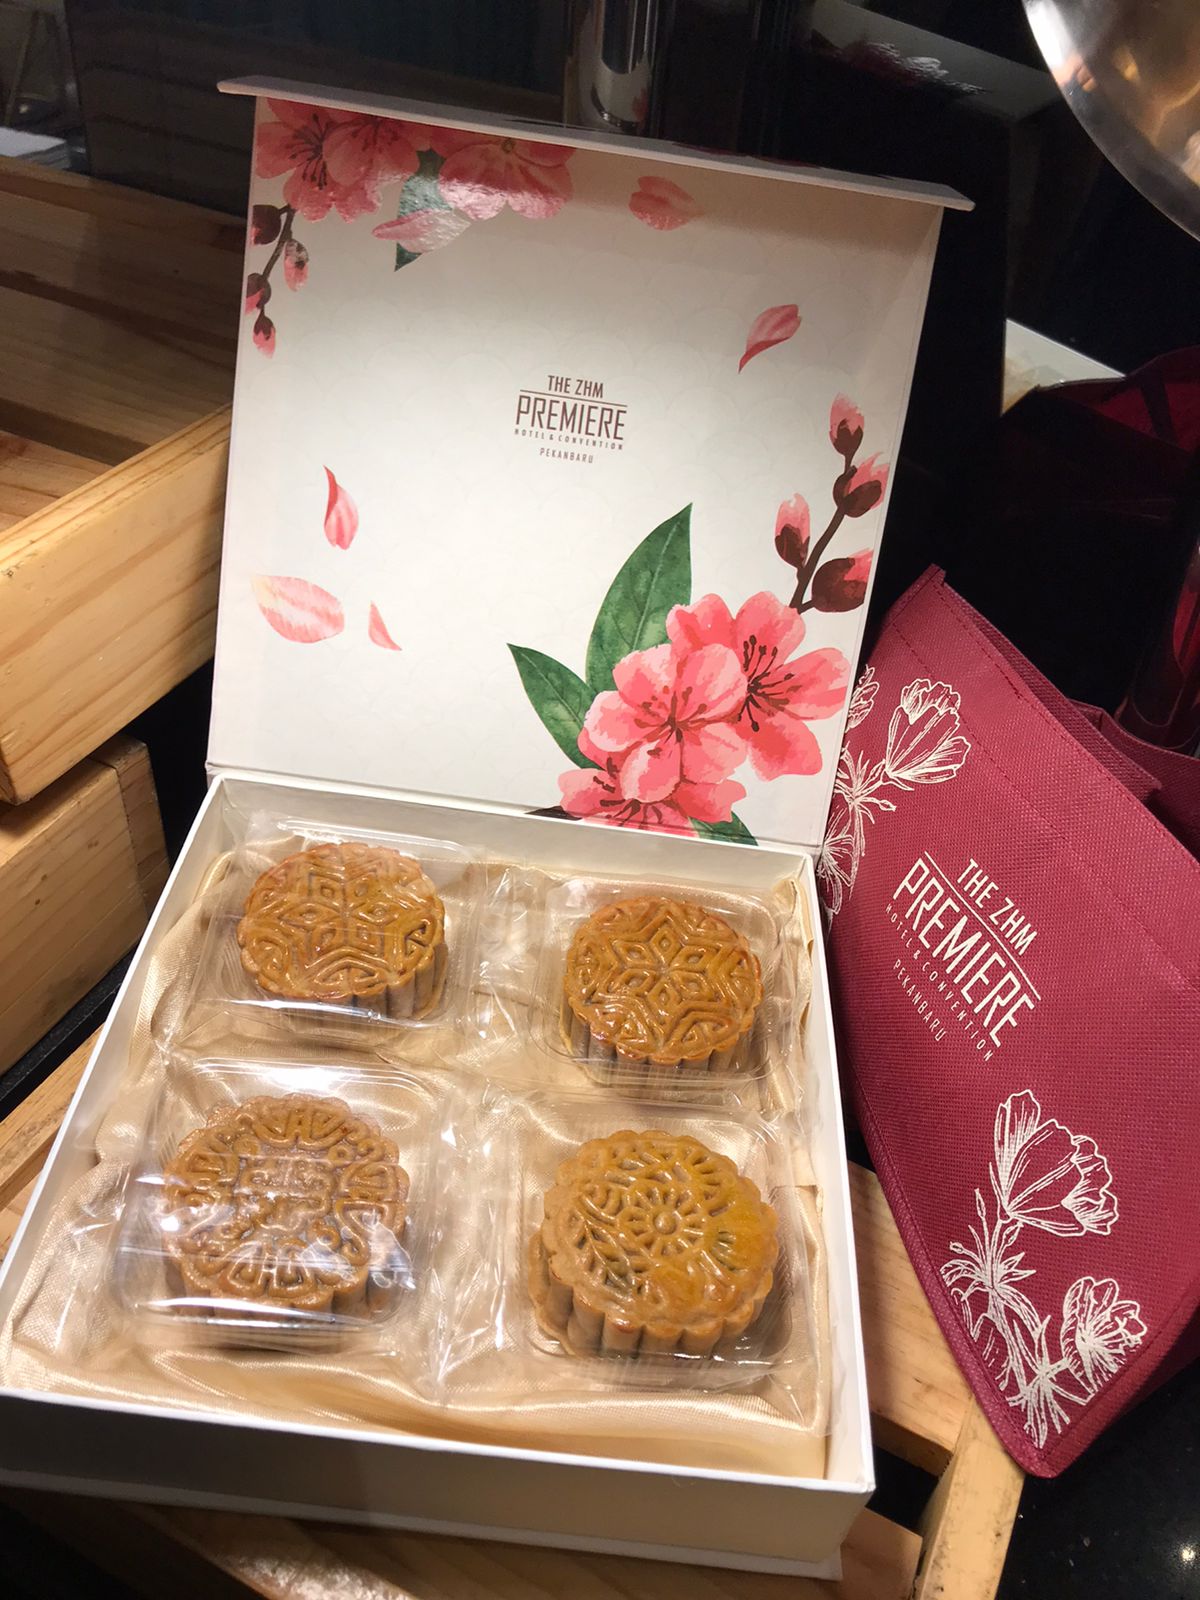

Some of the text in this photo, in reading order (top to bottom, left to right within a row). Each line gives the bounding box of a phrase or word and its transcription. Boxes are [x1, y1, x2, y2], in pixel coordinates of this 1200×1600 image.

[516, 395, 627, 440] PREMIERE
[548, 375, 603, 398] THE ZHM
[515, 429, 544, 439] HOTEL
[558, 435, 623, 450] CONVENTION
[540, 447, 594, 463] PEKANBARU
[957, 858, 1037, 956] THE ZHM
[886, 903, 994, 1061] HOTEL & CONVENTION
[893, 858, 1035, 1047] PREMIERE
[893, 959, 947, 1042] PEKANBARU
